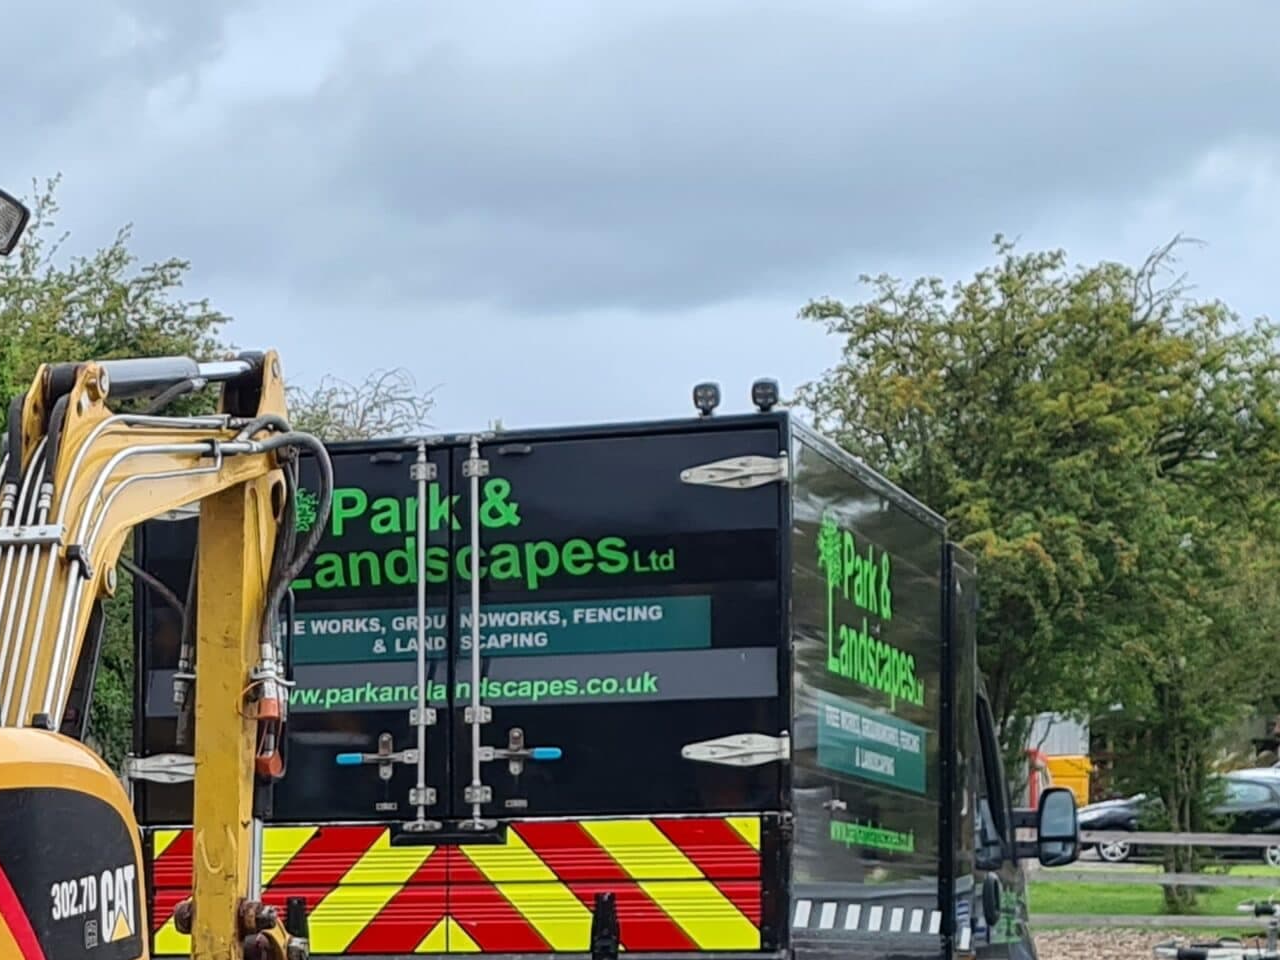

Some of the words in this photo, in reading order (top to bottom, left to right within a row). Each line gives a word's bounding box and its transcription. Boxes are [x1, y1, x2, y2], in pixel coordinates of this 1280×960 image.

[331, 482, 461, 536] Park
[479, 477, 521, 528] &
[291, 536, 629, 590] andscapes
[633, 548, 676, 573] Ltd
[843, 530, 878, 615] Park
[880, 551, 892, 622] &
[311, 617, 387, 635] WORKS,
[573, 605, 664, 625] FENCING
[372, 638, 387, 654] &
[827, 588, 916, 711] Landscapes
[50, 875, 97, 921] 302.7D
[101, 864, 135, 943] CAT
